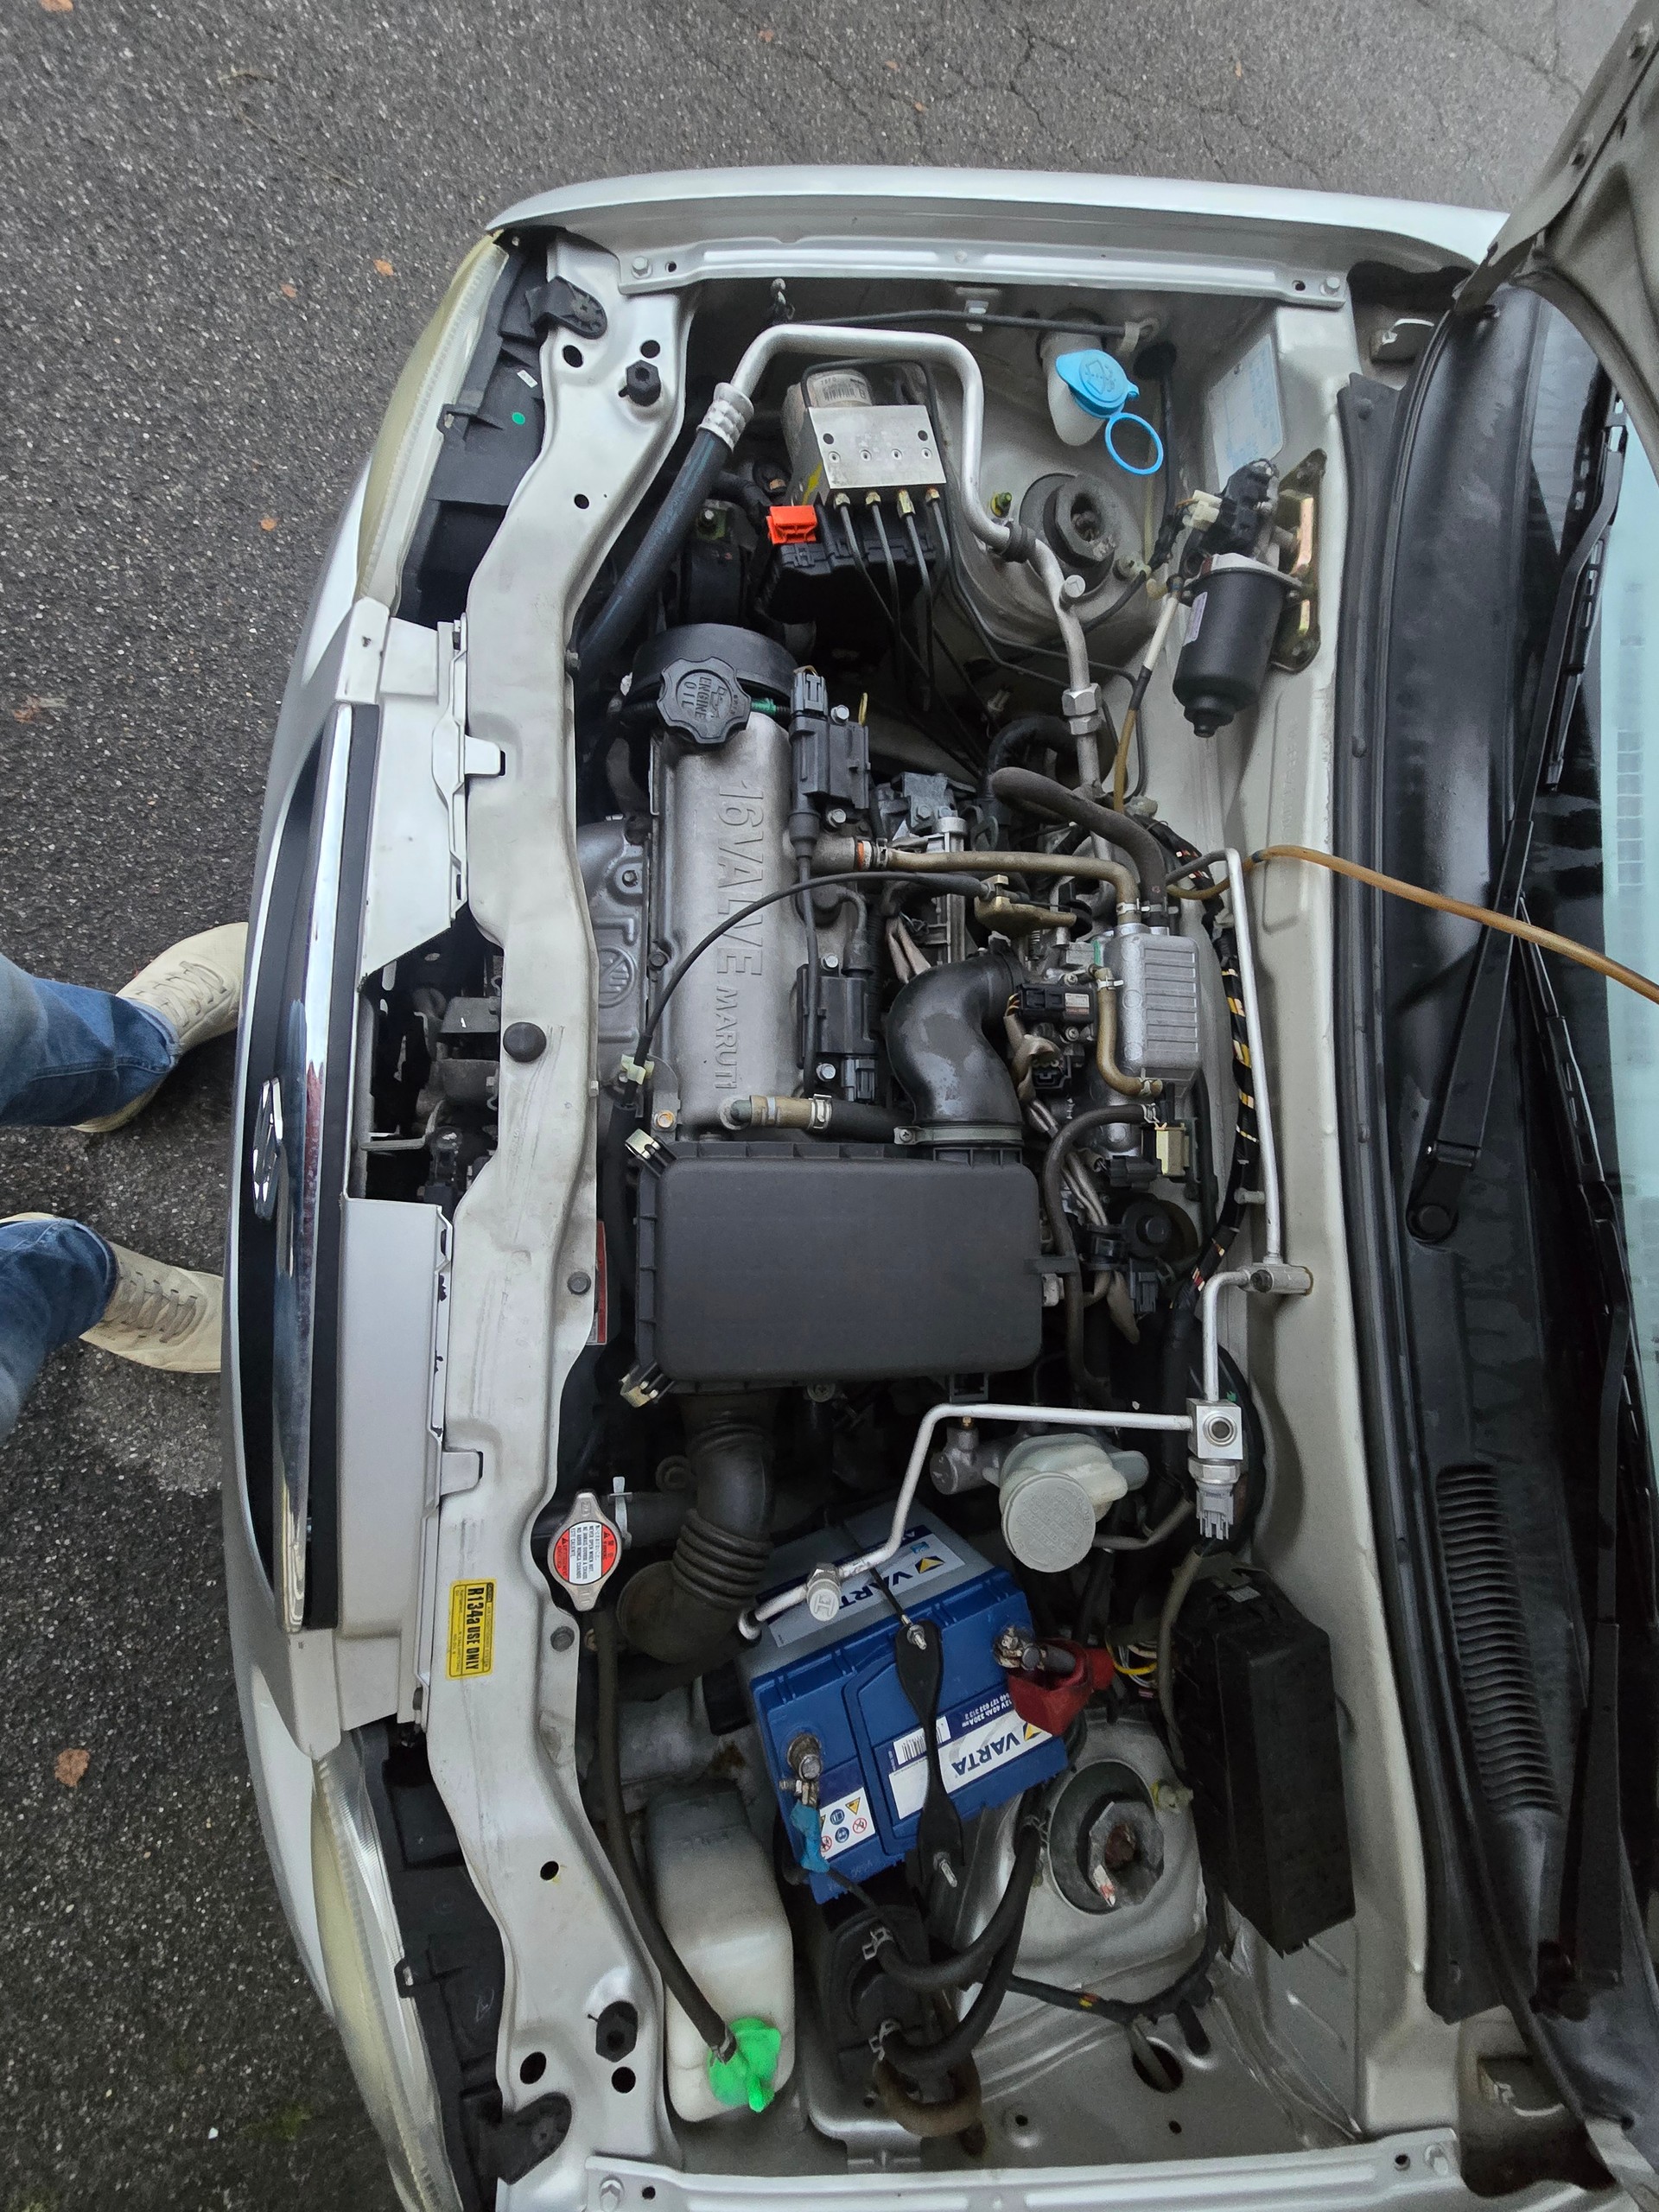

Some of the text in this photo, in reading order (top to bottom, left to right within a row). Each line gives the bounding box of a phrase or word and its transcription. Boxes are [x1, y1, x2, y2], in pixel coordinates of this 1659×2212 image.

[682, 681, 697, 709] OIL
[695, 677, 712, 721] ENGINE
[715, 986, 738, 1090] MARUTI
[814, 1594, 836, 1618] H
[839, 1571, 913, 1610] VART
[466, 1587, 485, 1669] R134a USE ONLY
[985, 1705, 1001, 1717] 40Ah
[951, 1732, 1021, 1777] VARTA
